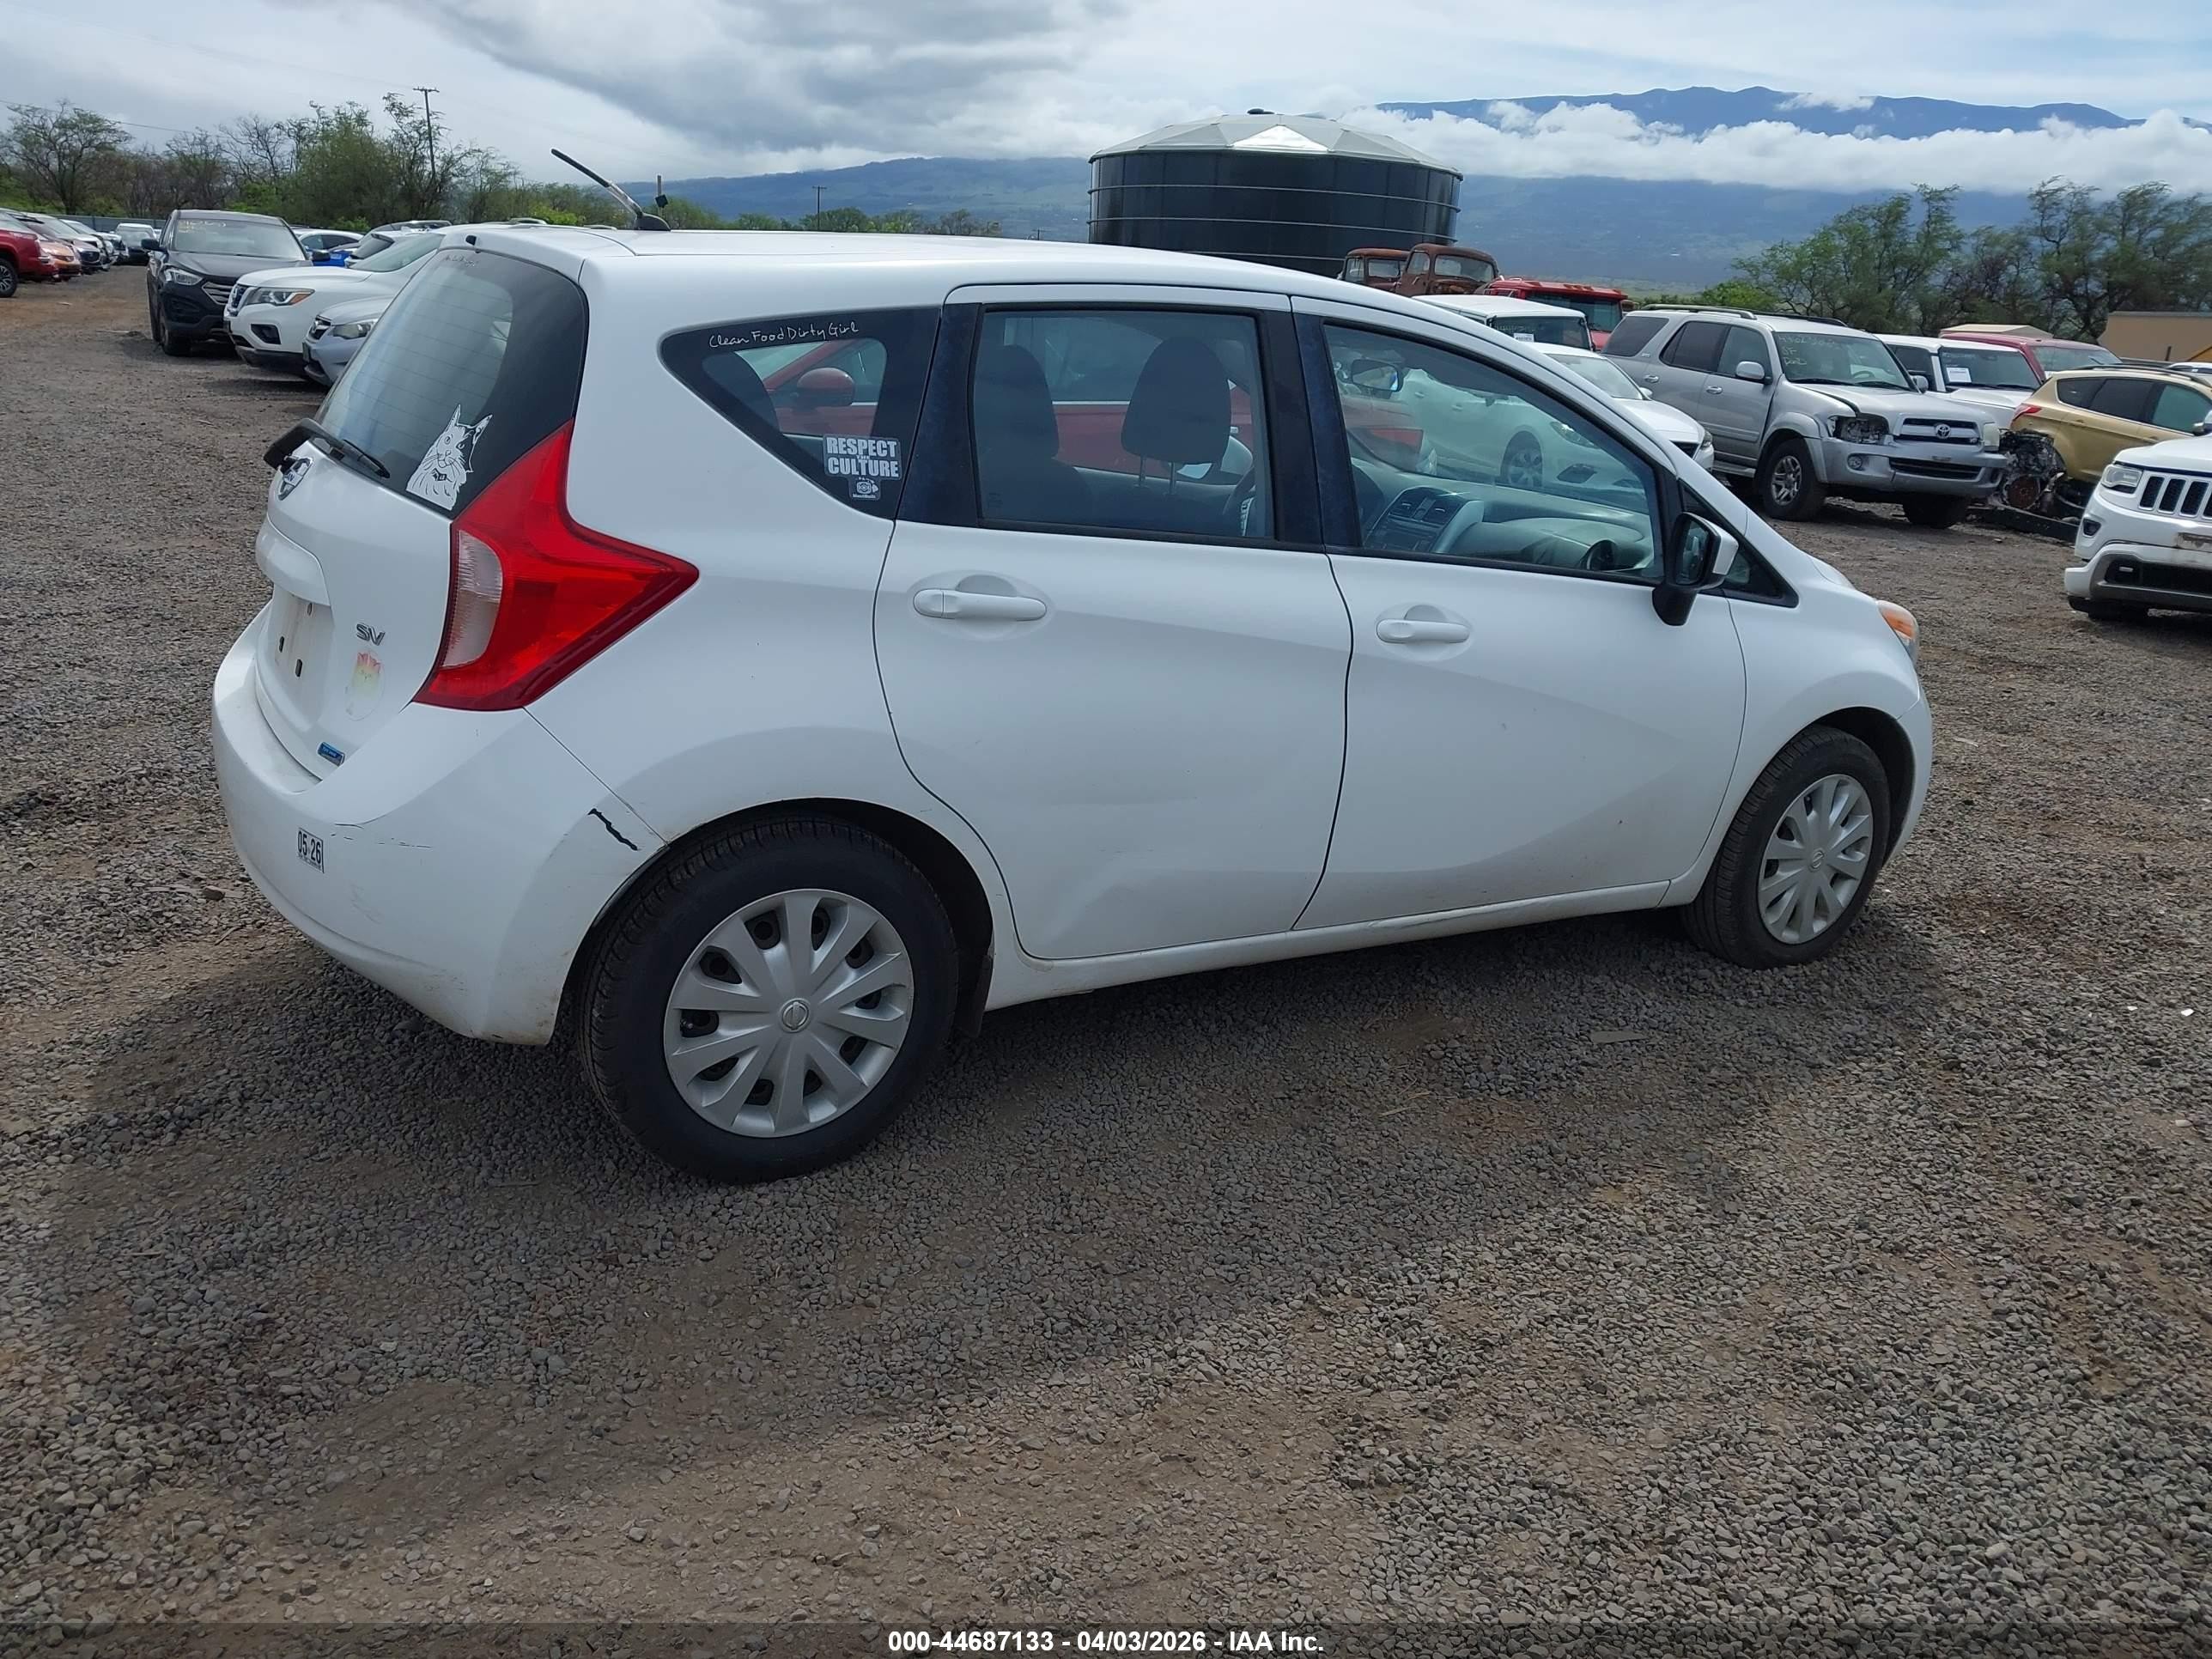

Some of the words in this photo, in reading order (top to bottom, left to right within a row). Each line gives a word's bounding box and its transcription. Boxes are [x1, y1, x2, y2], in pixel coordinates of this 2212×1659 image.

[709, 335, 750, 348] Clean
[750, 327, 785, 342] Food
[787, 324, 826, 340] Dirty
[828, 321, 860, 336] Girl
[826, 437, 897, 458] RESPECT
[828, 457, 899, 477] CULTURE
[356, 623, 386, 646] SV
